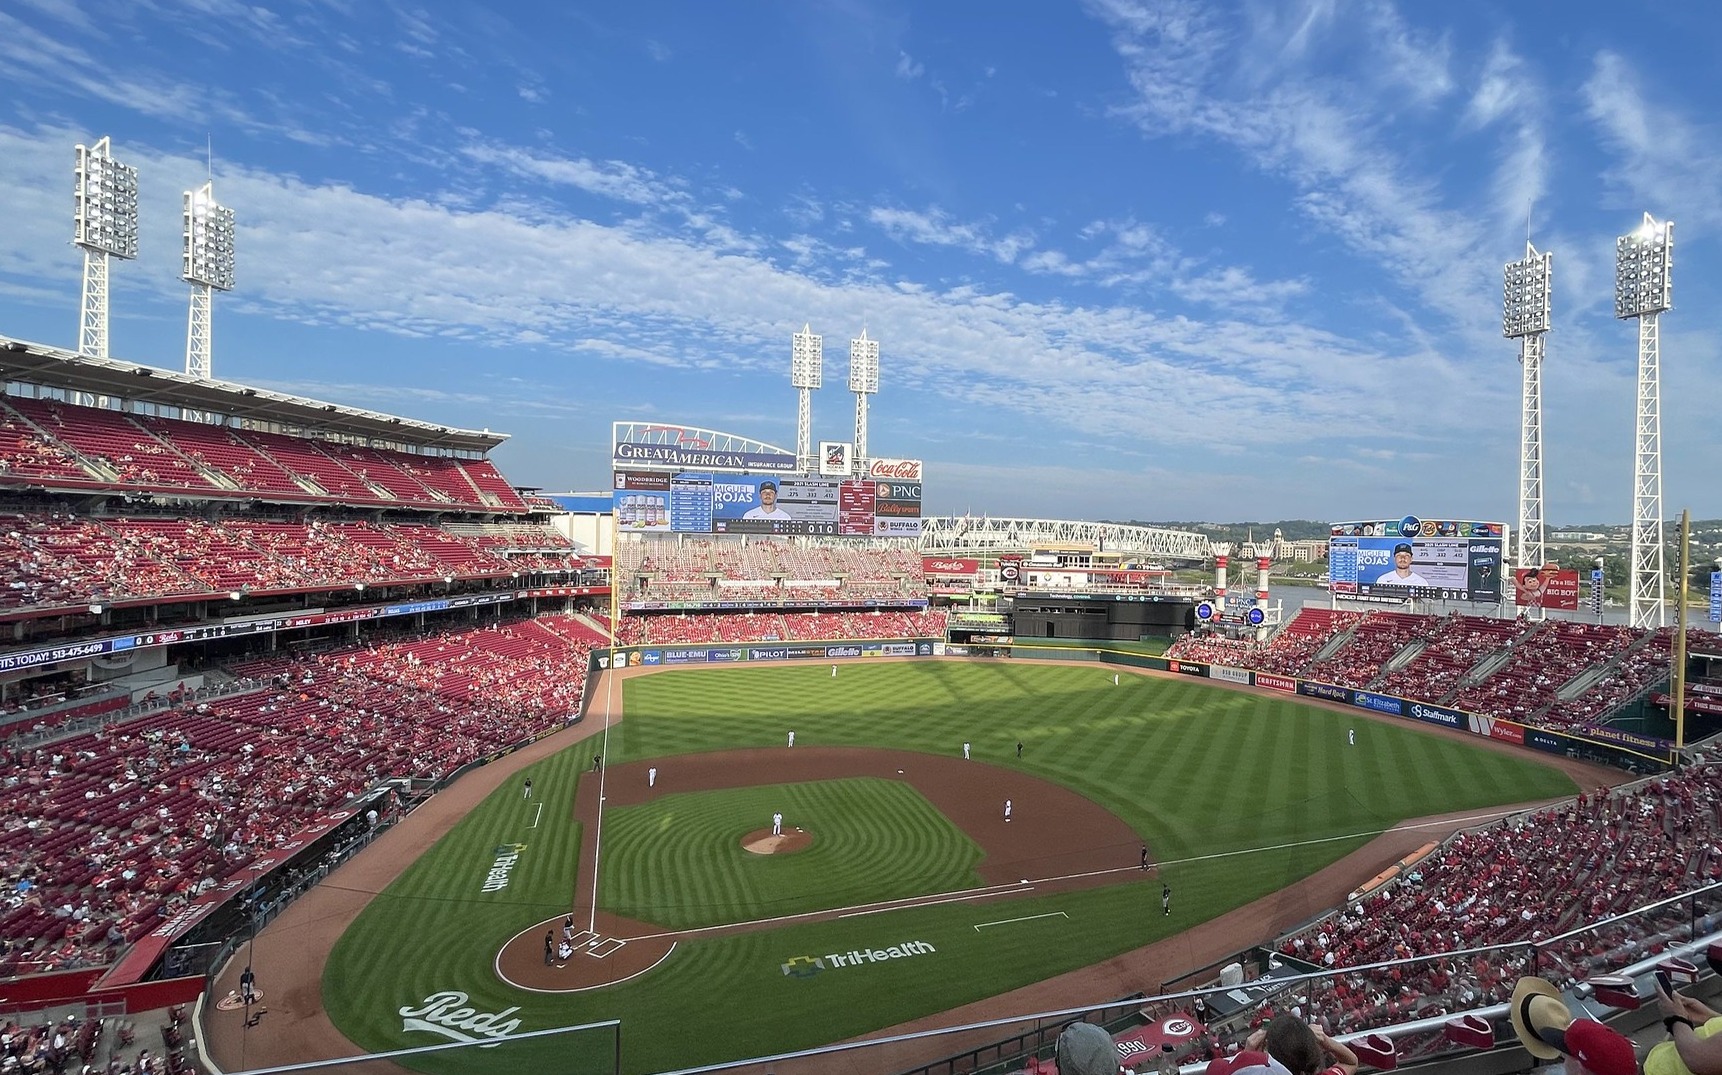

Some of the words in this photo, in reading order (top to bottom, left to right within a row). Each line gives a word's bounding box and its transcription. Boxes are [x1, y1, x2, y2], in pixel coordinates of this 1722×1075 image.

[627, 476, 668, 484] WOODBRIDGE
[714, 485, 750, 493] MIGUEL
[892, 486, 920, 498] PNC
[714, 493, 753, 503] ROJAS
[878, 503, 901, 515] Bally
[809, 525, 815, 533] 0
[1403, 523, 1419, 531] P&G
[1470, 545, 1500, 553] Gillette
[930, 561, 964, 569] Reds
[1358, 556, 1388, 565] ROJAS
[1442, 591, 1449, 599] 0
[1461, 592, 1468, 600] 0
[146, 636, 154, 644] 0
[158, 632, 179, 642] Reds
[15, 652, 49, 665] TODAY!
[52, 644, 103, 659] 513-475-6499
[760, 650, 784, 658] PILOT
[828, 647, 860, 656] Gillette
[1180, 664, 1200, 673] TOYOTA
[1257, 676, 1294, 689] CRAFTSMAN
[1317, 686, 1332, 695] Hard
[1332, 689, 1346, 699] Rock
[1373, 698, 1400, 709] Elizabeth
[1422, 709, 1457, 724] Staffmark
[1539, 737, 1557, 746] DELTA
[1590, 728, 1620, 740] planet
[1622, 733, 1656, 748] fitness
[825, 940, 936, 968] TriHealth
[399, 991, 522, 1048] Reds
[1170, 1021, 1190, 1032] REDS
